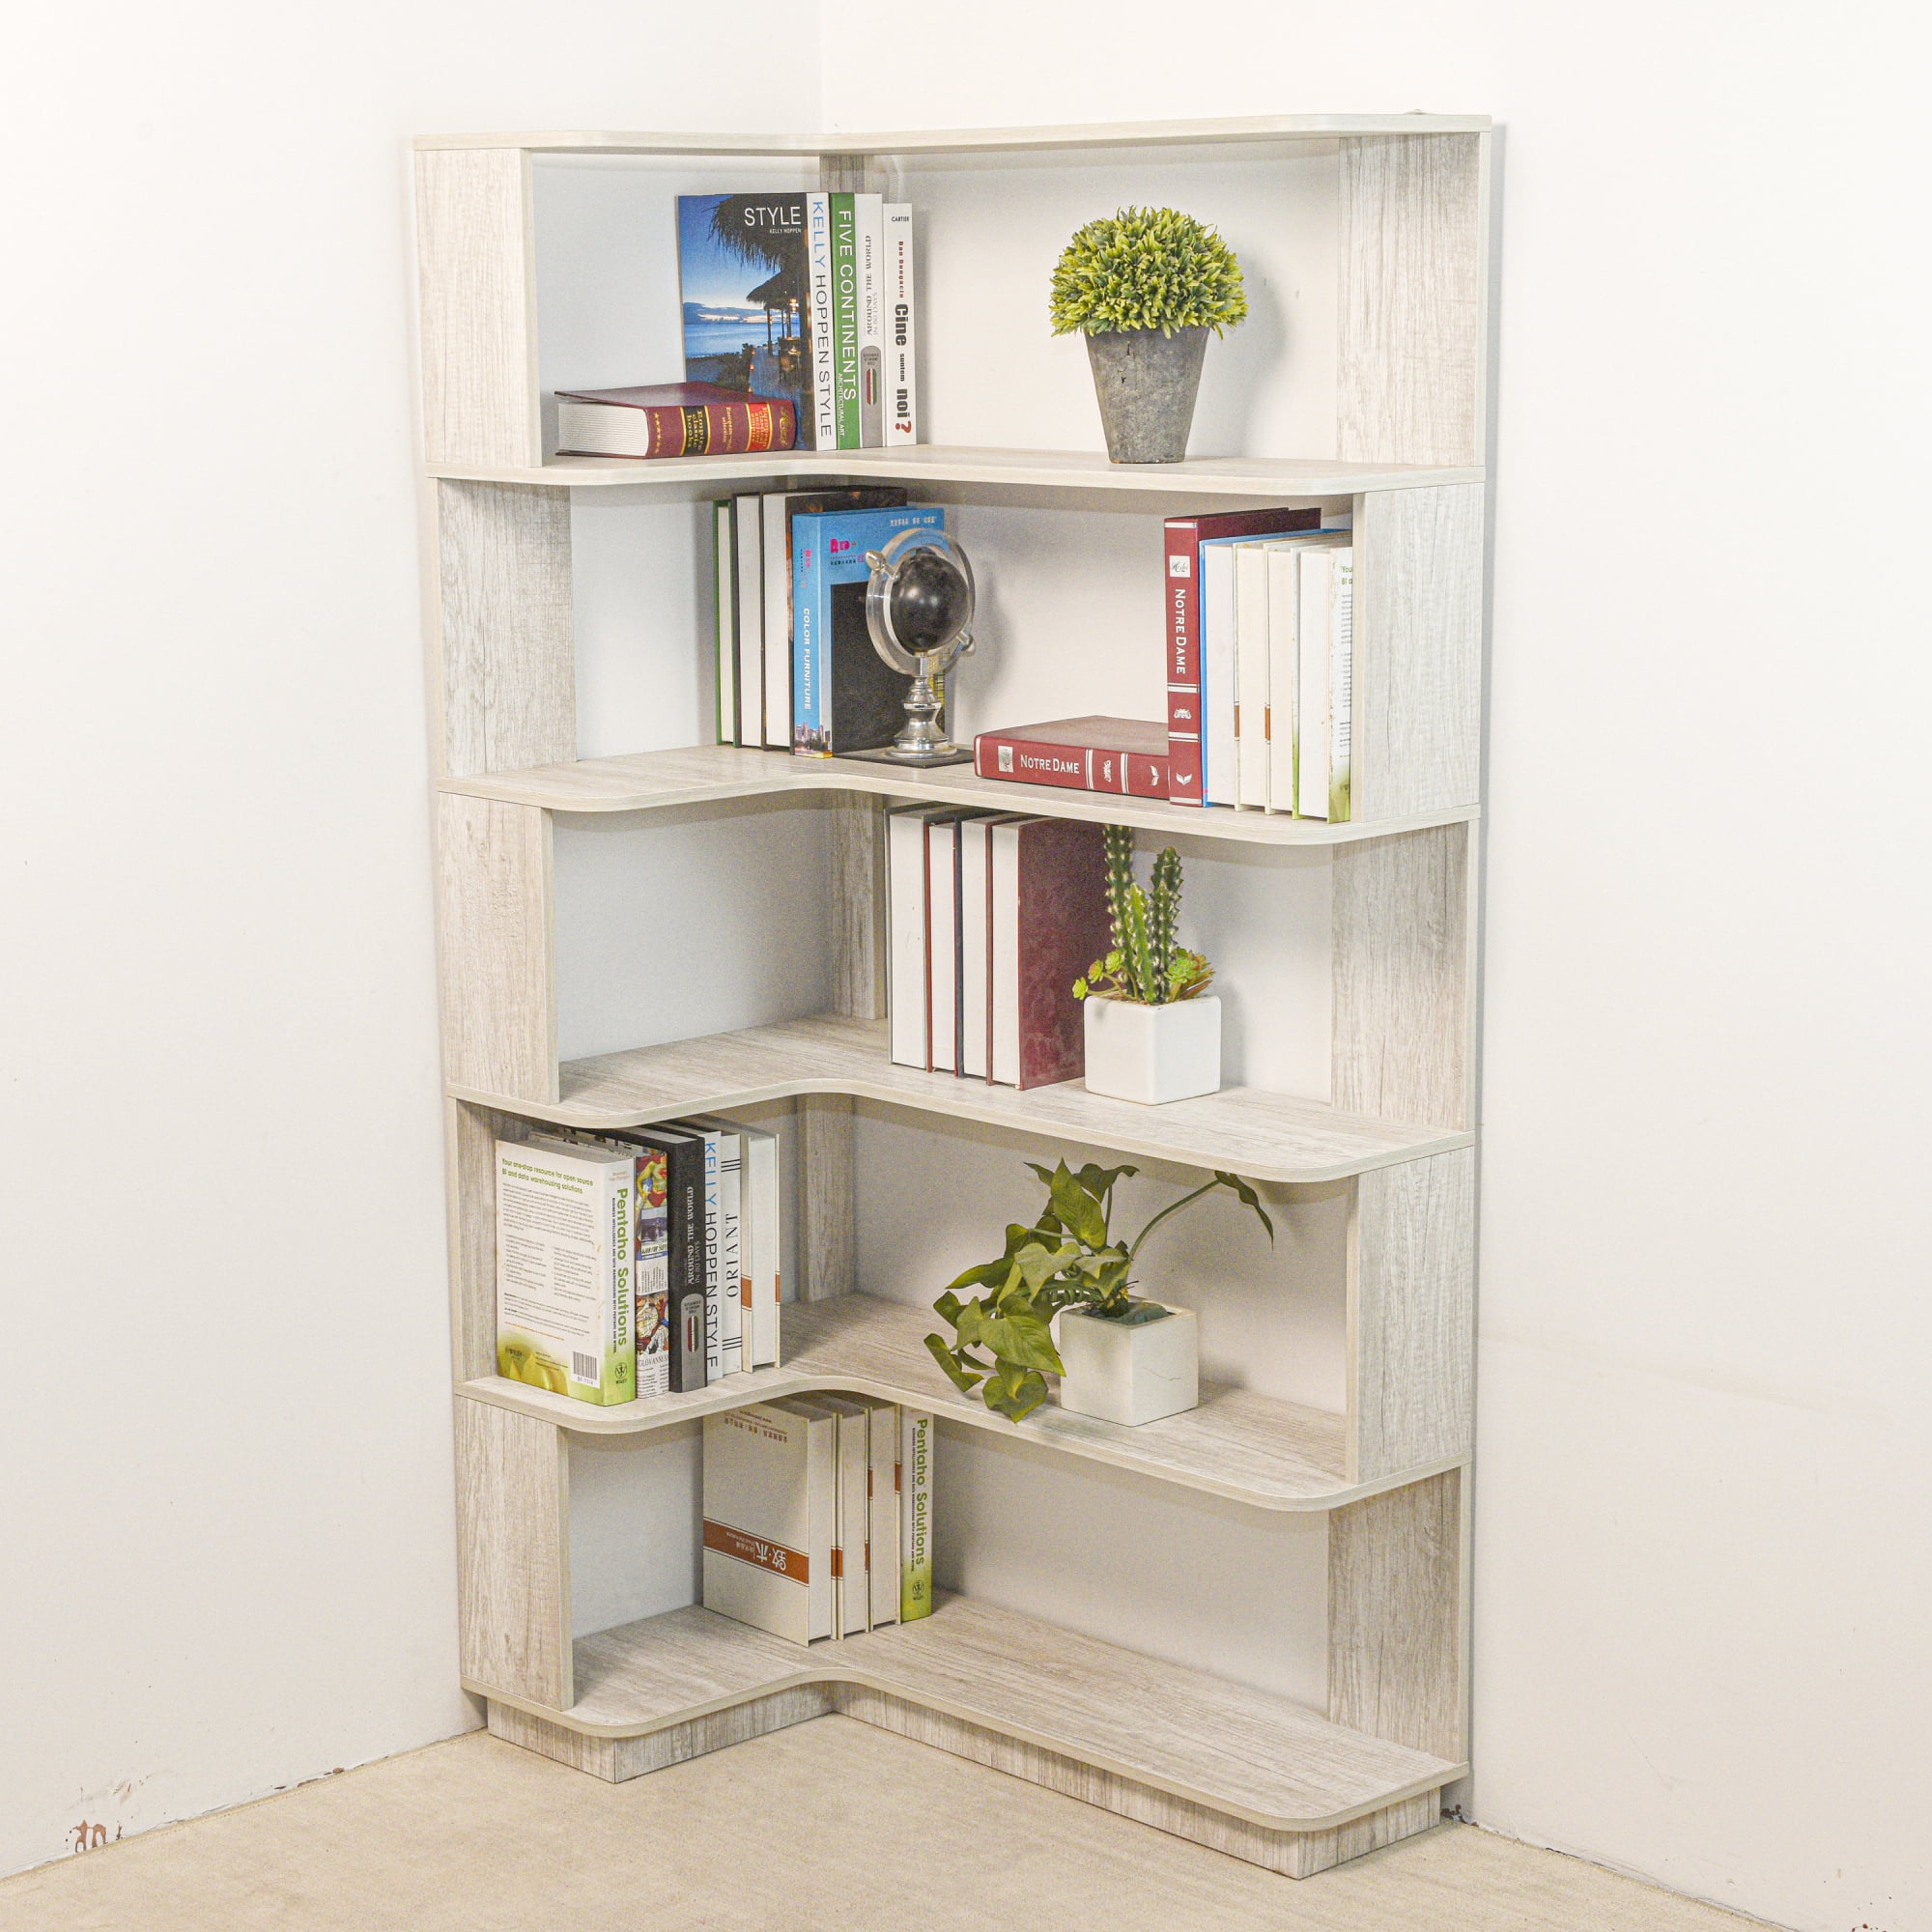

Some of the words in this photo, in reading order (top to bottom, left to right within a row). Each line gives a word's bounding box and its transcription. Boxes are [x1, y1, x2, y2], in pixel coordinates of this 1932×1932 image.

[744, 206, 802, 227] STYLE
[812, 201, 826, 268] KELLY
[838, 210, 853, 258] FIVE
[865, 235, 873, 270] WORLD
[865, 272, 873, 291] THE
[815, 274, 830, 363] HOPPEN
[839, 264, 857, 401] CONTINENTS
[895, 303, 909, 347] Cine
[818, 370, 832, 438] STYLE
[803, 608, 811, 646] COLOR
[1175, 588, 1186, 634] NOTRE
[803, 647, 811, 710] FURNITURE
[1176, 636, 1187, 675] DAME
[1020, 753, 1051, 772] NOTRE
[1052, 757, 1079, 775] DAME
[501, 1158, 513, 1167] Your
[533, 1167, 555, 1178] resource
[563, 1174, 576, 1182] open
[577, 1177, 594, 1186] source
[530, 1177, 561, 1190] warehousing
[561, 1183, 582, 1194] solutions
[617, 1187, 629, 1261] Pentaho
[704, 1211, 718, 1297] HOPPEN
[724, 1213, 739, 1298] ORIANT
[617, 1267, 629, 1347] Solutions
[917, 1418, 928, 1486] Pentaho
[916, 1492, 928, 1565] Solutions
